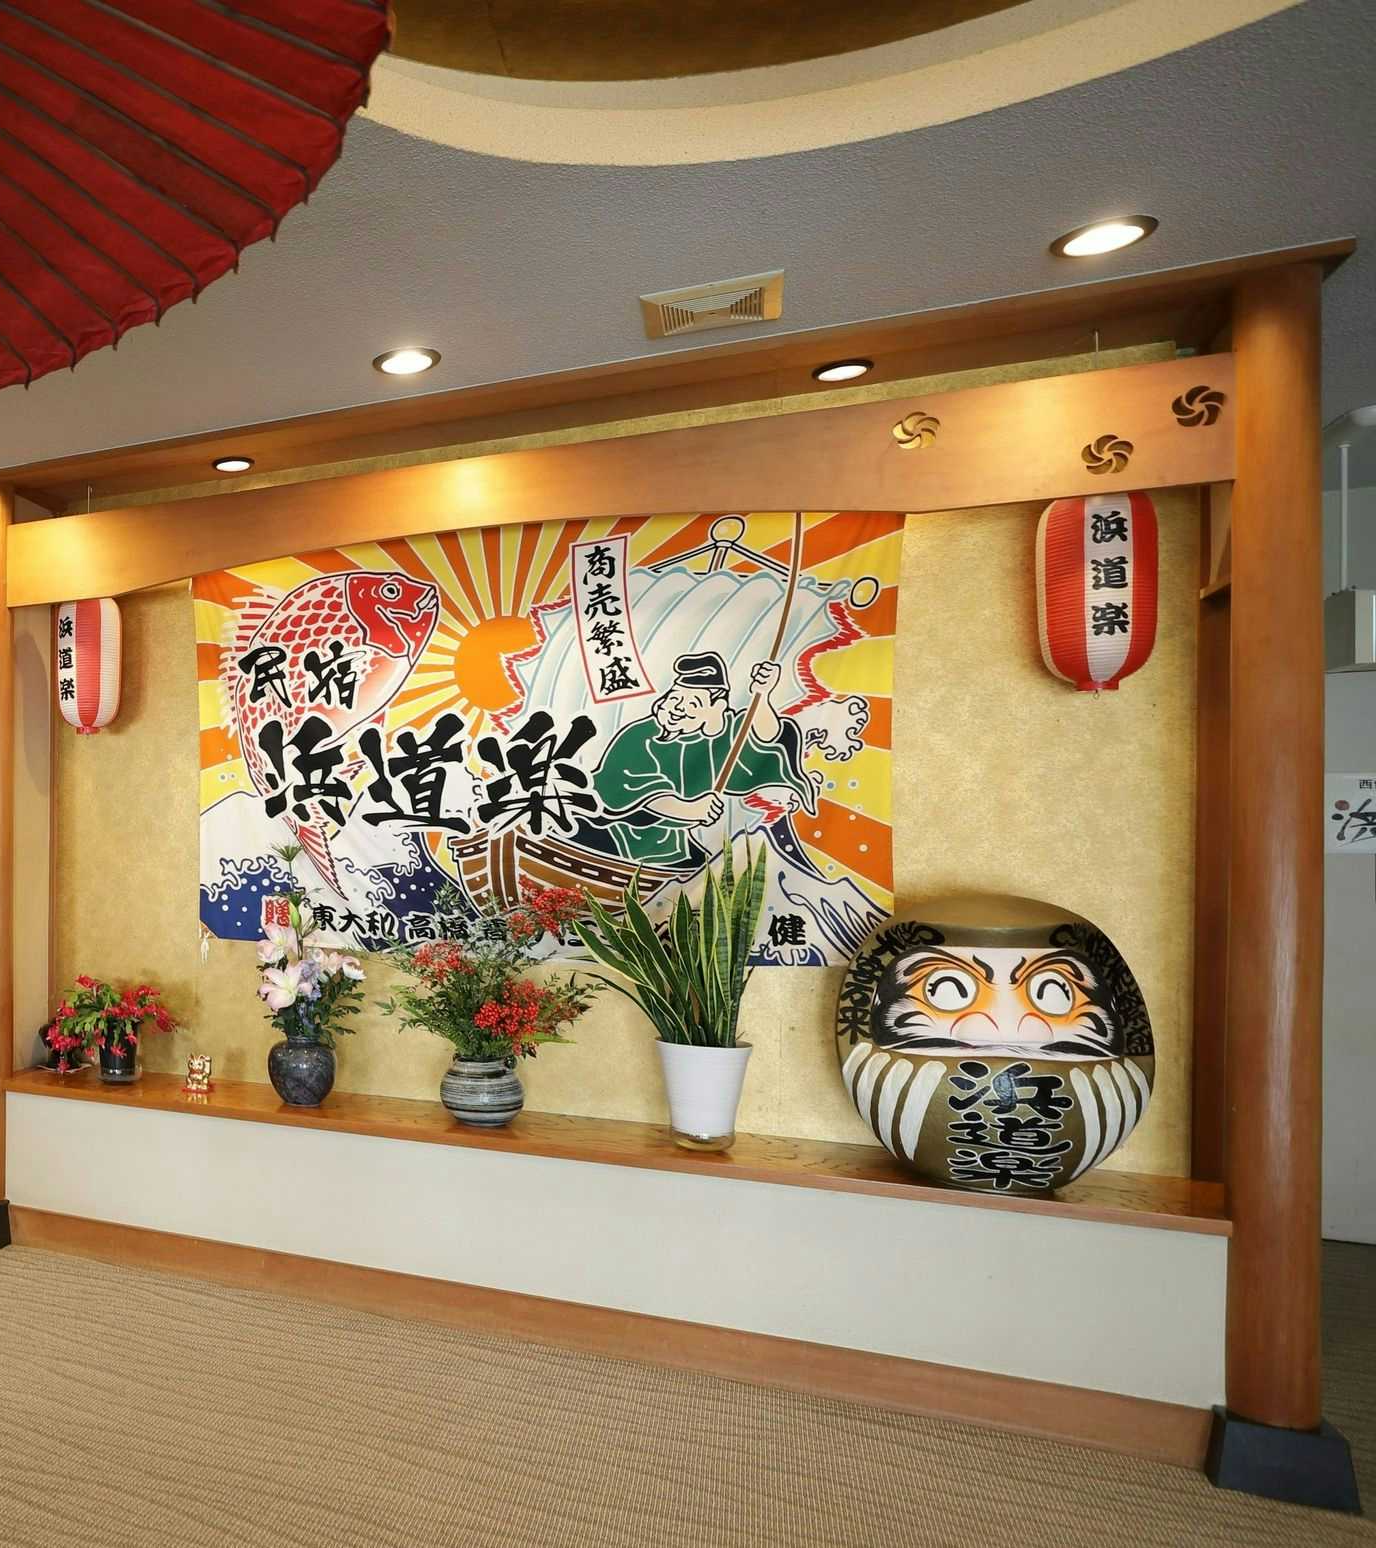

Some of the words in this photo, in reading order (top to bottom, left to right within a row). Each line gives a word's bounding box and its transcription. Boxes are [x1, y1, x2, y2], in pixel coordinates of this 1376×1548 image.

[582, 545, 640, 695] 商売繁盛
[1091, 511, 1130, 636] 浜道楽
[58, 616, 75, 701] 浜道楽
[238, 640, 366, 709] 民宿
[259, 711, 602, 834] 浜道楽
[313, 903, 395, 938] 東大和
[406, 912, 469, 942] 高橋
[768, 913, 807, 947] 健
[947, 1061, 1073, 1189] 浜道楽
